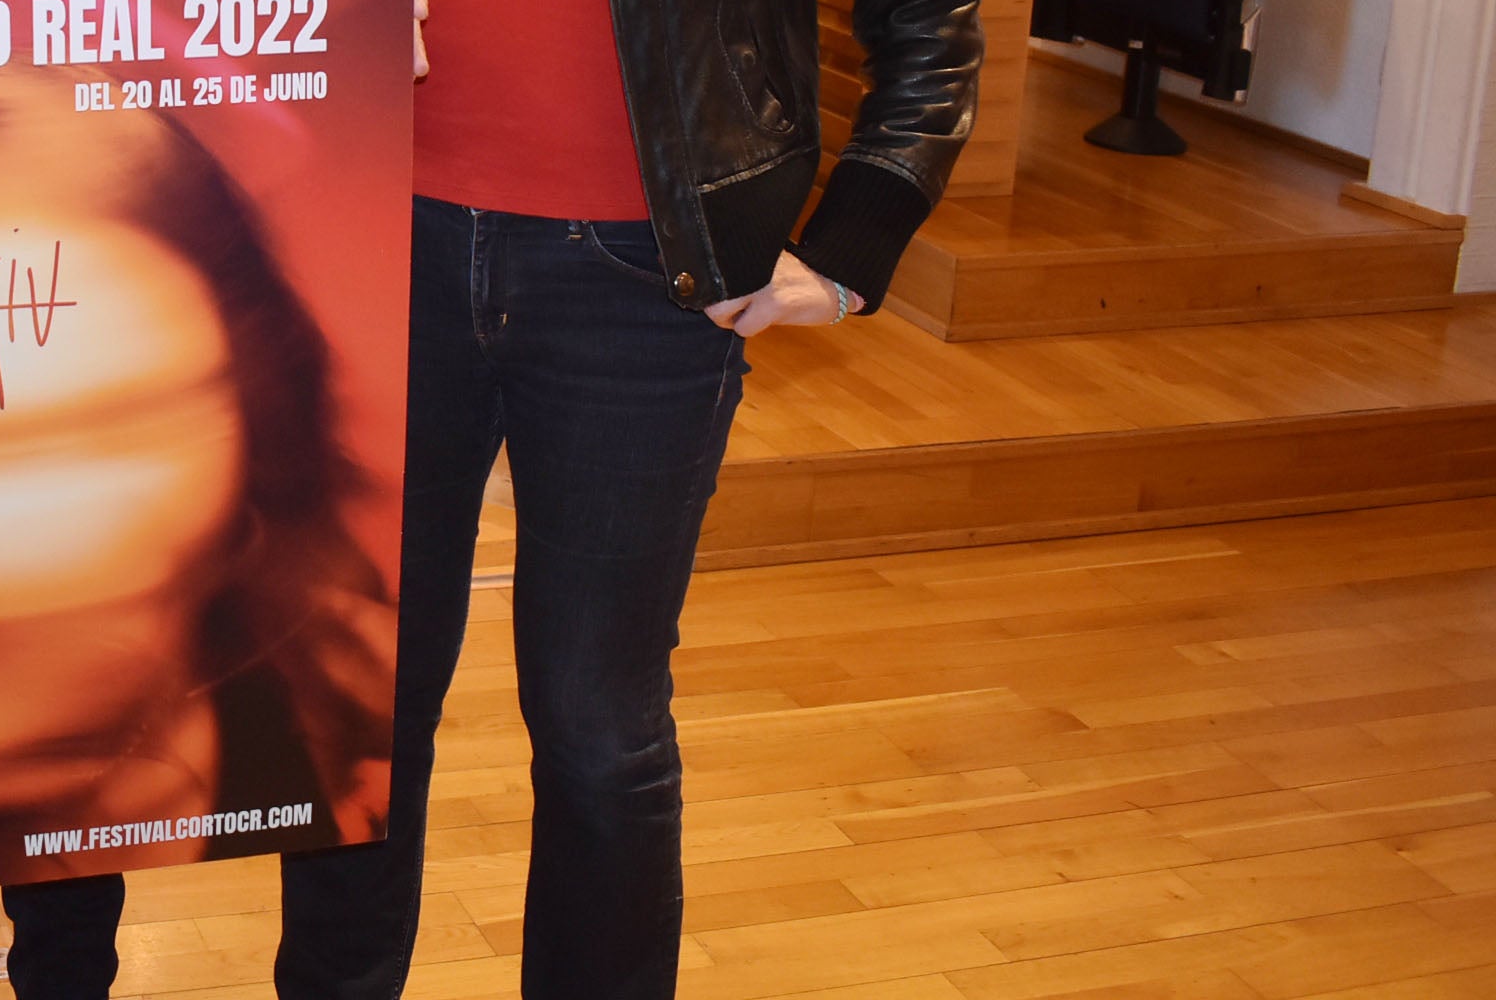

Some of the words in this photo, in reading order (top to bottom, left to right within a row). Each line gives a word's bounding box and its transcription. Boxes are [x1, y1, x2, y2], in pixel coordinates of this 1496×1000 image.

[74, 82, 116, 112] DEL
[121, 80, 153, 109] 20
[158, 78, 187, 108] AL
[193, 76, 223, 106] 25
[229, 75, 257, 104] DE
[263, 71, 328, 102] JUNIO
[24, 802, 313, 857] WWW.FESTIVALCORTOCR.COM
